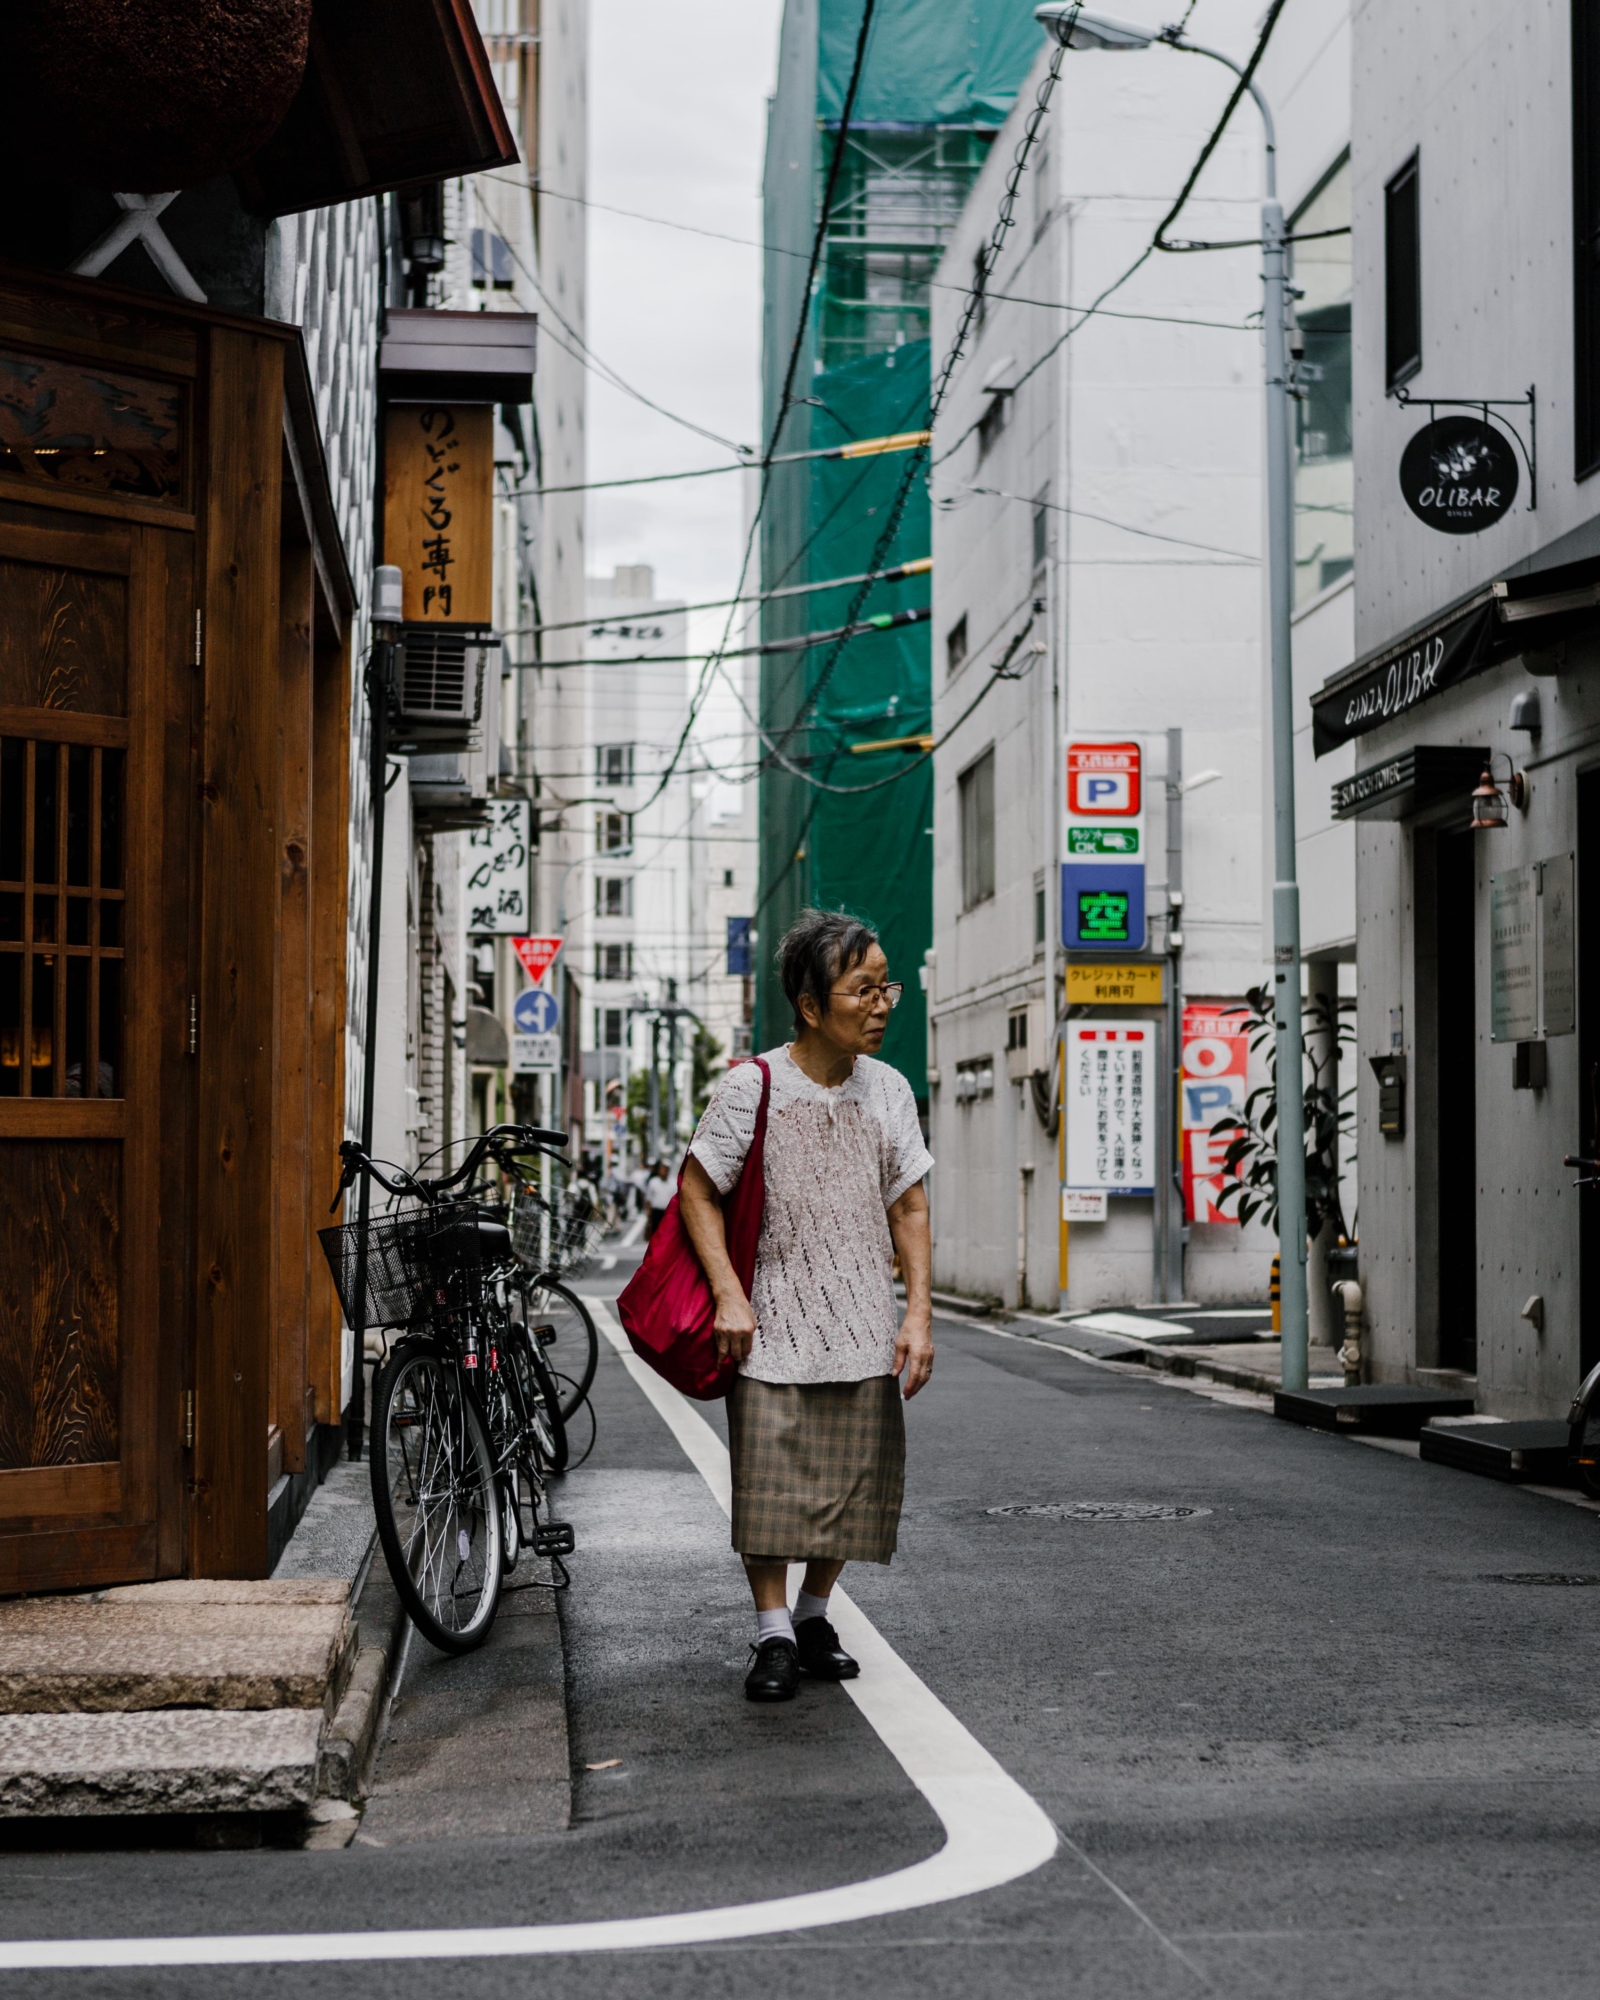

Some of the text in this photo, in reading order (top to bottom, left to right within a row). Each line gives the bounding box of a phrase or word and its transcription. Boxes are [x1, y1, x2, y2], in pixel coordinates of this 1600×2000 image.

[1418, 486, 1501, 507] OLIBAR
[420, 406, 460, 616] のどぐろ専門
[1446, 510, 1474, 518] GINZA
[1345, 636, 1444, 725] GINZA OLIBAR
[1087, 779, 1117, 802] P
[1071, 829, 1103, 841] クレジット
[1075, 842, 1098, 853] OK
[1079, 891, 1128, 940] 空
[1070, 969, 1159, 982] クレジットカード
[1094, 985, 1135, 998] 利用可
[1079, 1049, 1091, 1096] ください
[1096, 1049, 1108, 1180] 際は十分にお気をつけて
[1184, 1037, 1242, 1222] OPEN
